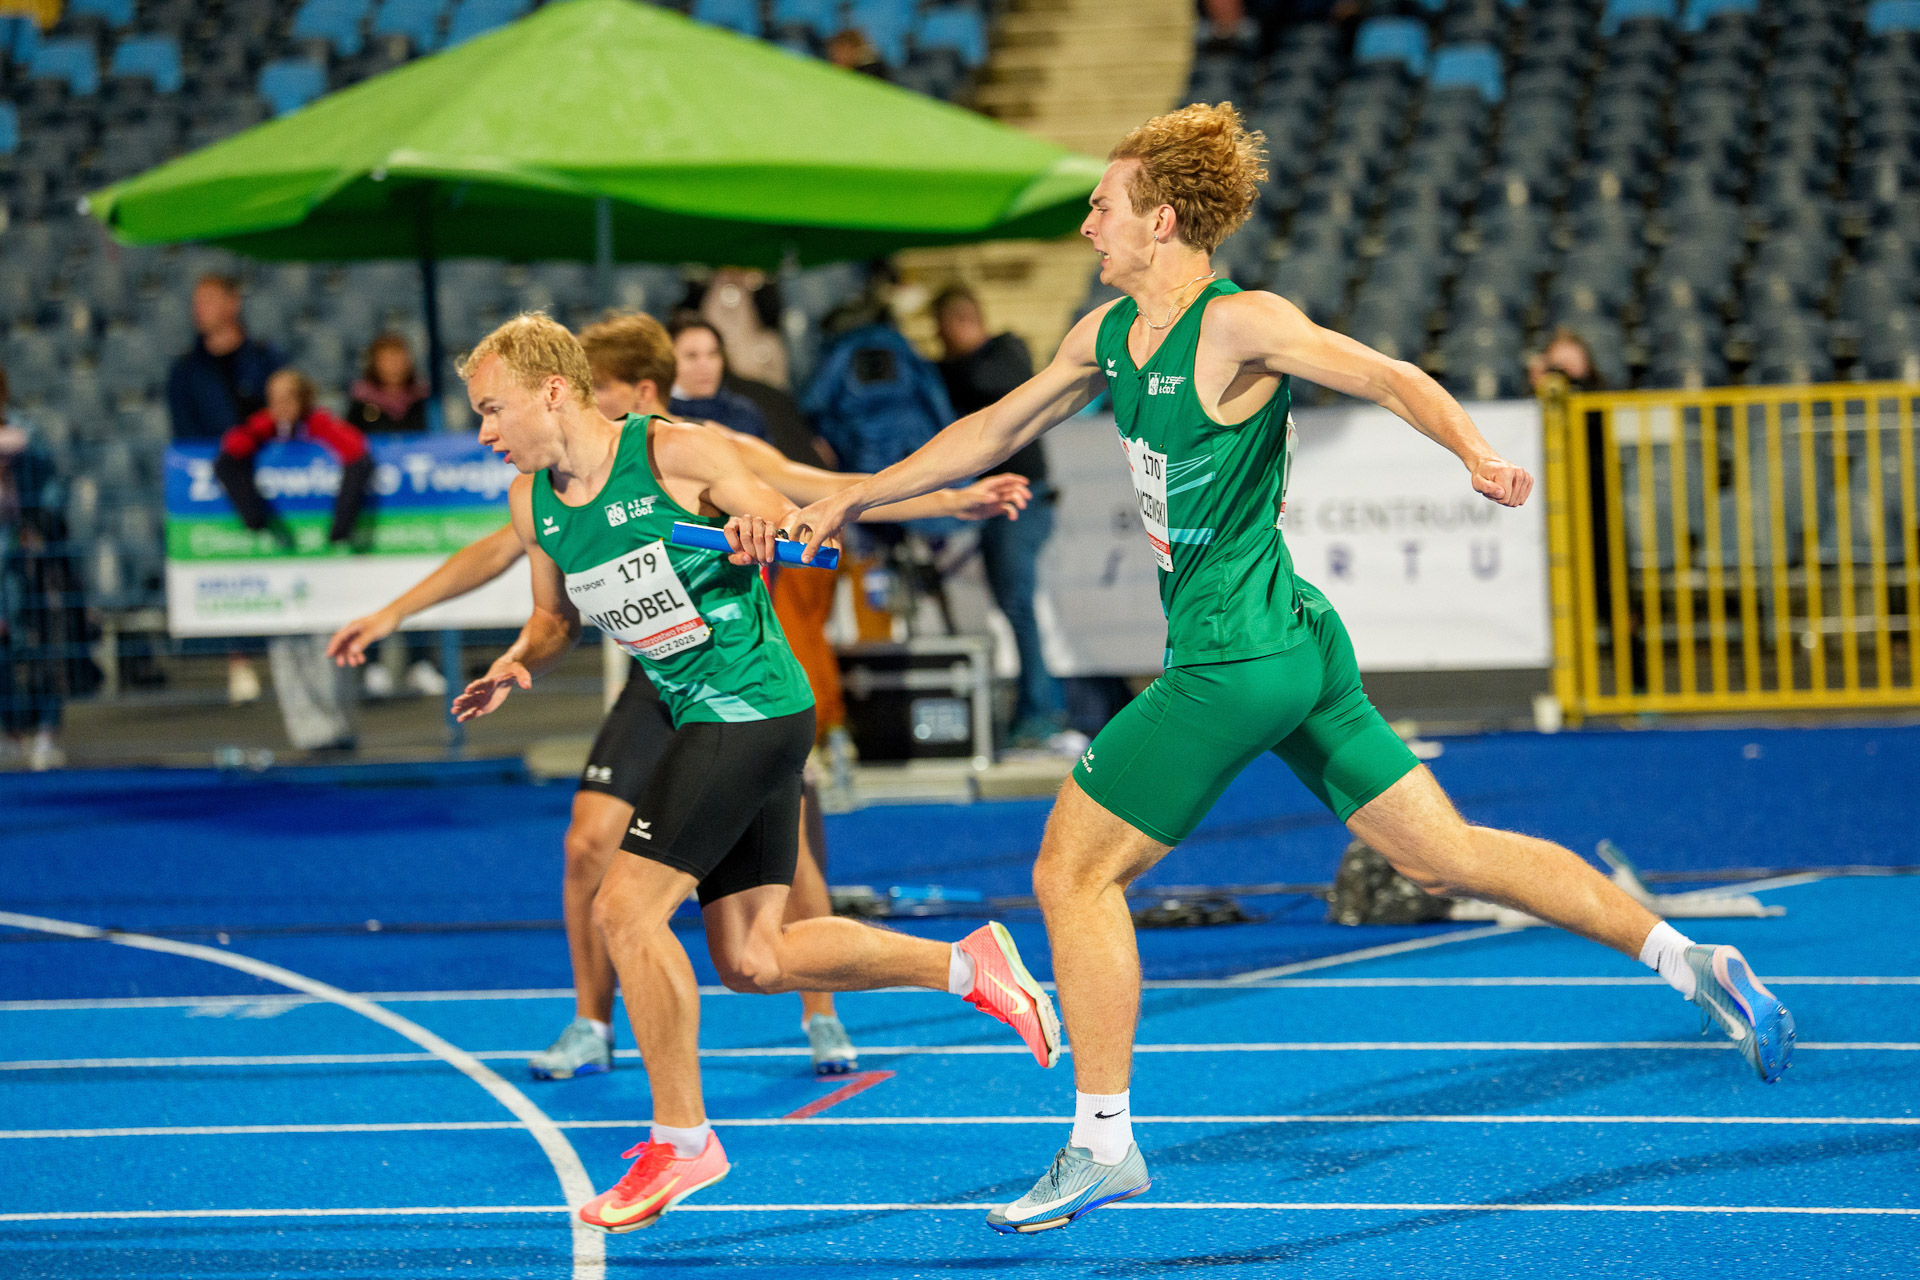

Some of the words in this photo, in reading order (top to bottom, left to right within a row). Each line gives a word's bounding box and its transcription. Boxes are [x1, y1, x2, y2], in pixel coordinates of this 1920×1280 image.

[1143, 453, 1161, 480] 170
[618, 552, 656, 584] 179
[569, 585, 583, 595] TVP
[582, 579, 606, 592] SPORT
[589, 589, 685, 631] WRÓBEL
[674, 634, 696, 648] 2025
